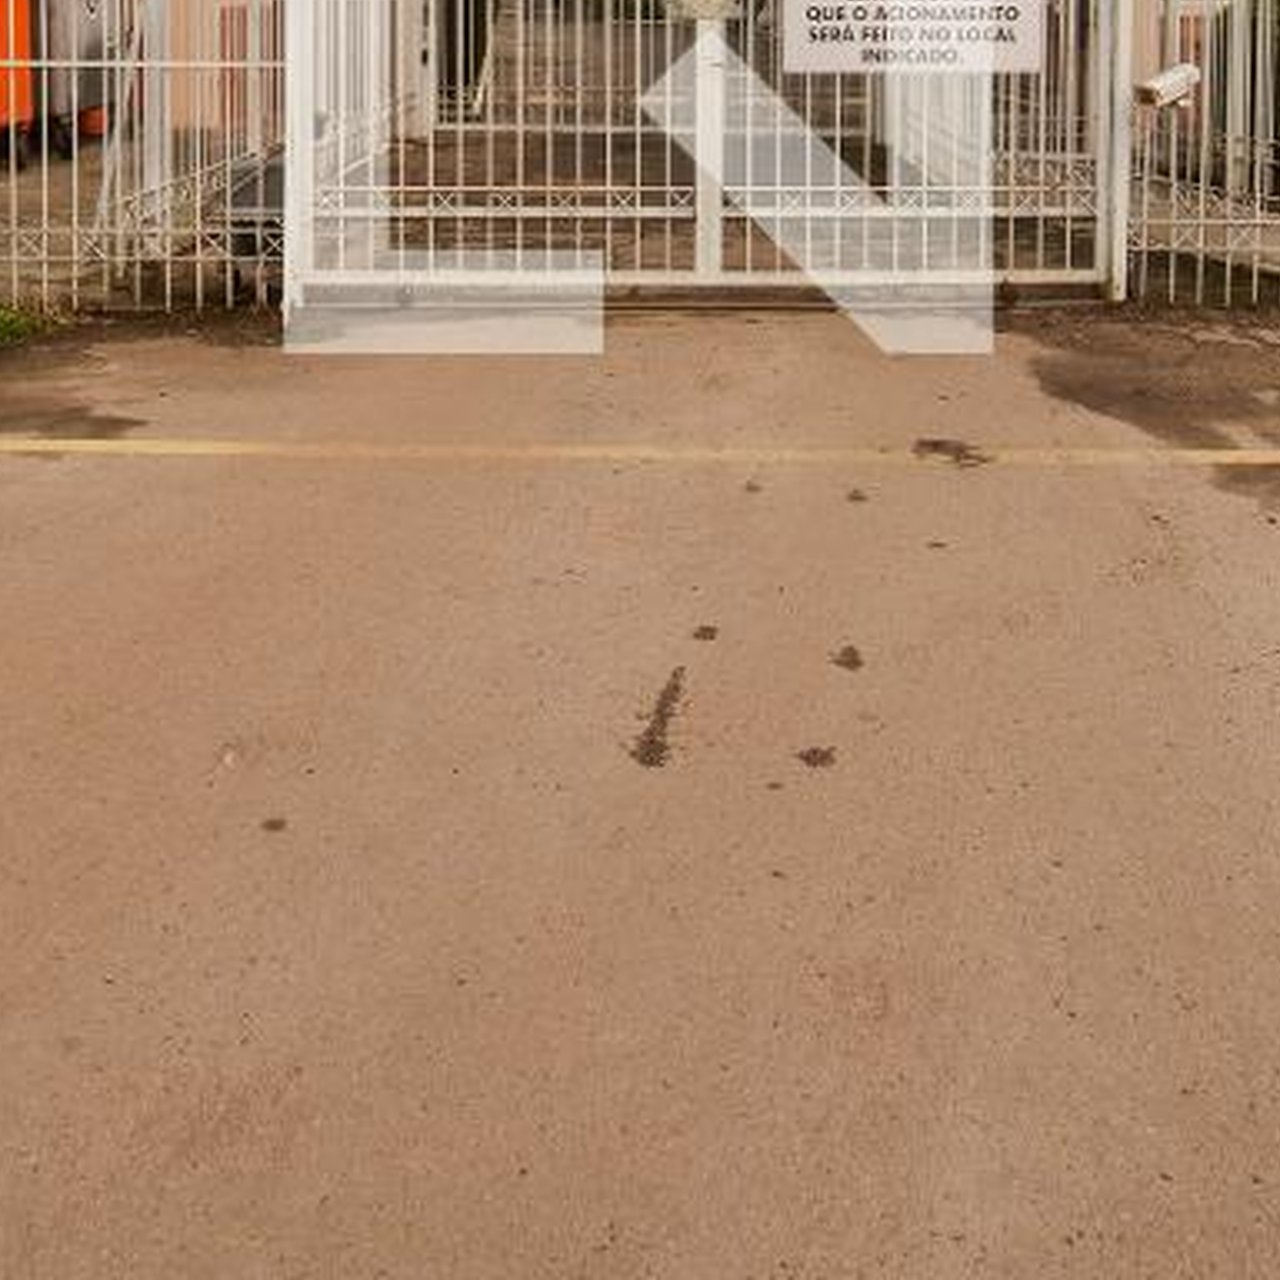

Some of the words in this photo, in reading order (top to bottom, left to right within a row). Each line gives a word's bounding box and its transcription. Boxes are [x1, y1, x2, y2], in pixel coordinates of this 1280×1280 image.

[806, 5, 846, 23] QUE
[852, 5, 869, 22] O
[873, 5, 1021, 22] ACIONAMENTO
[809, 23, 855, 43] SERÁ
[862, 26, 914, 43] FEITO
[918, 26, 952, 42] NO
[957, 26, 1016, 43] LOCAL
